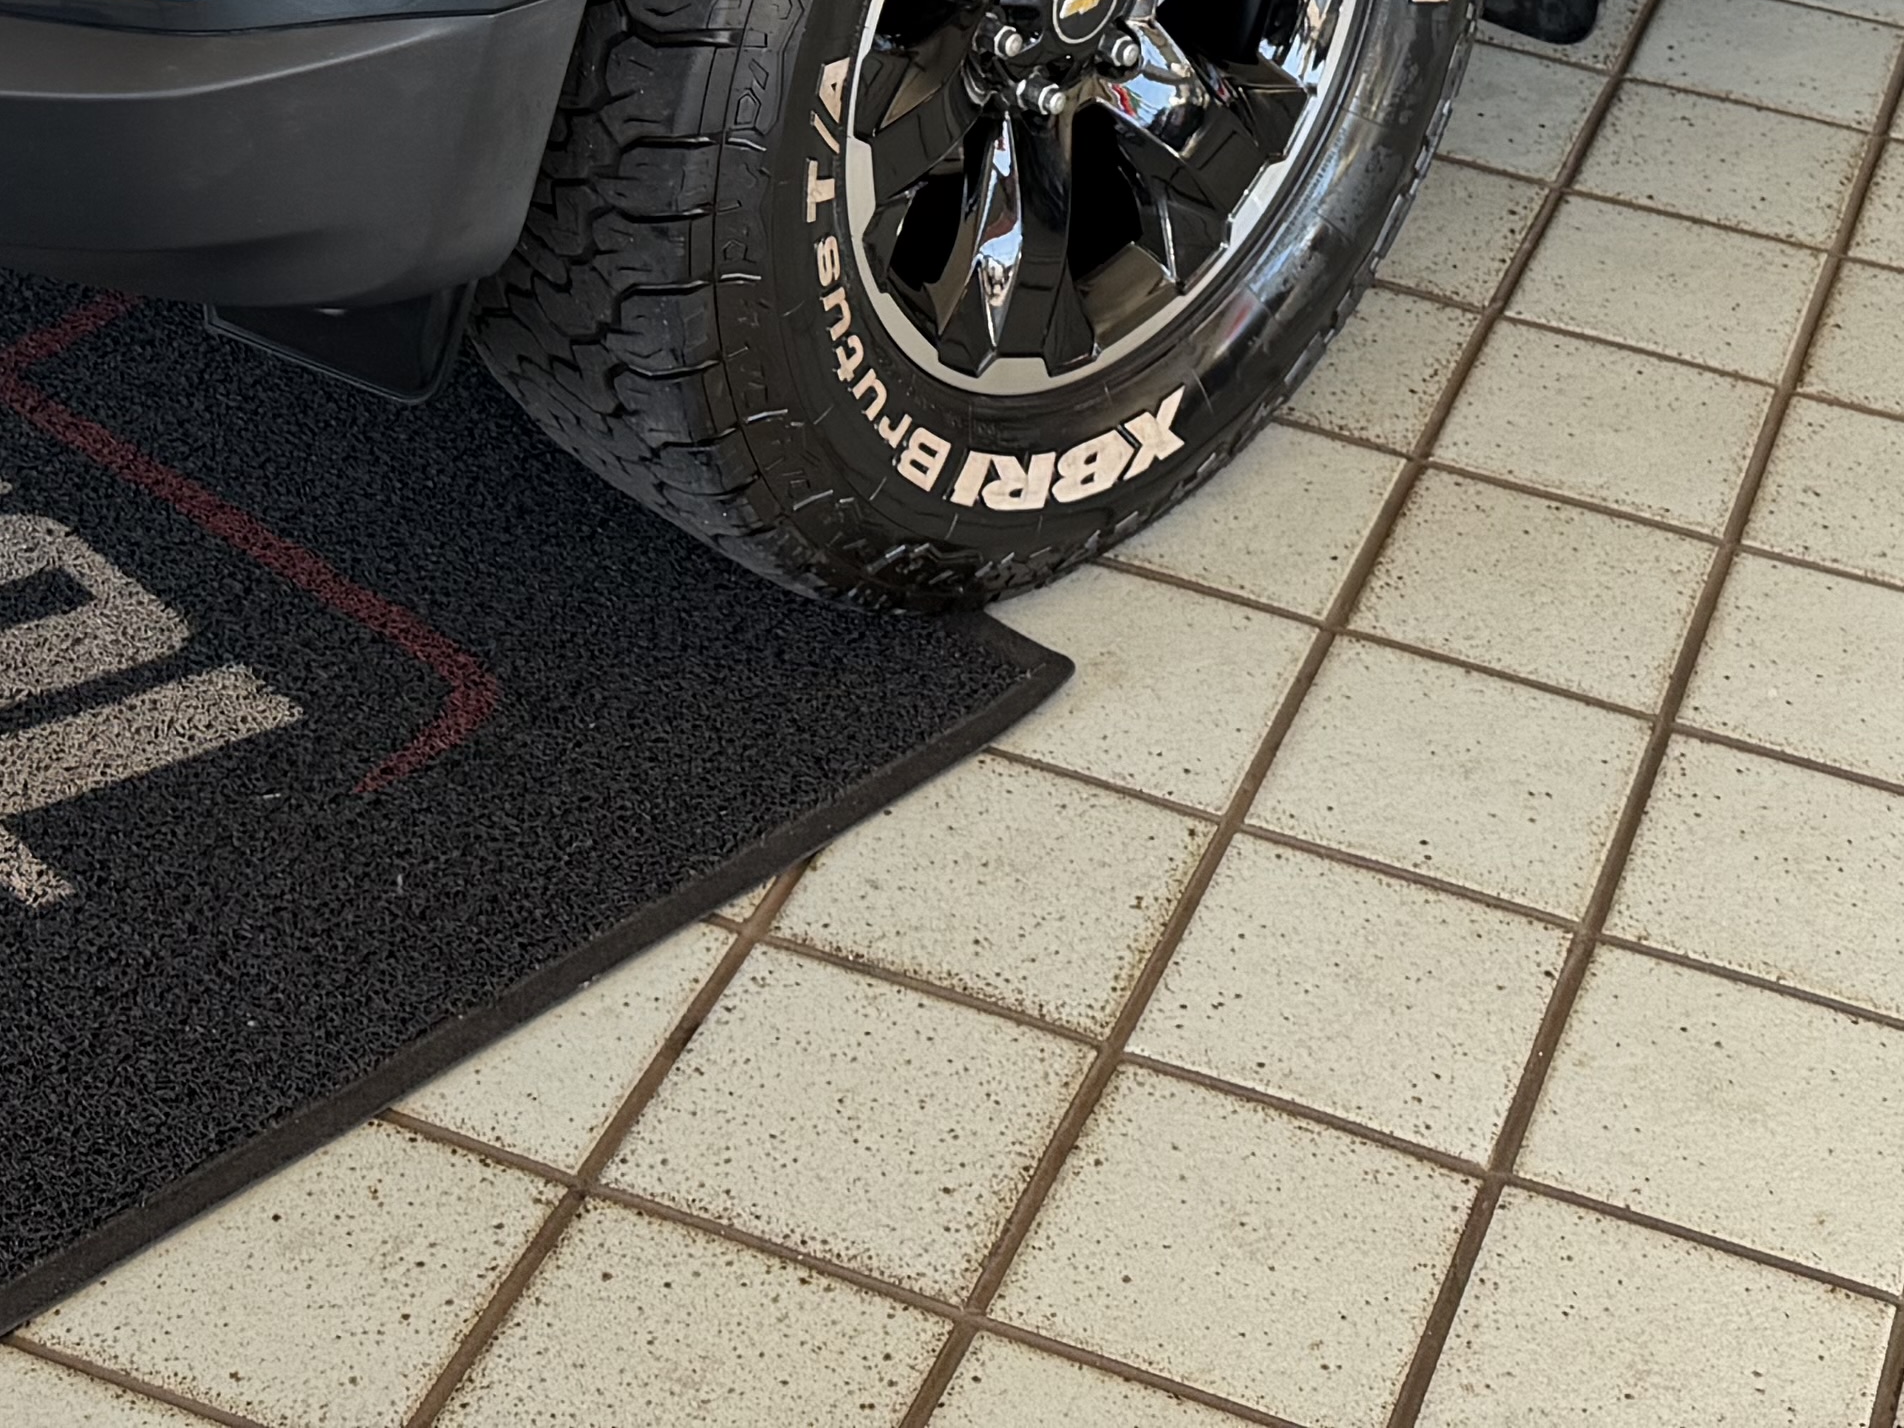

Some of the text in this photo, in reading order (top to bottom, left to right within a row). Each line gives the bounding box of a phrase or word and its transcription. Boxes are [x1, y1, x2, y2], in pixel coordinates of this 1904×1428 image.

[805, 56, 1186, 511] XBRI Brutus T/A
